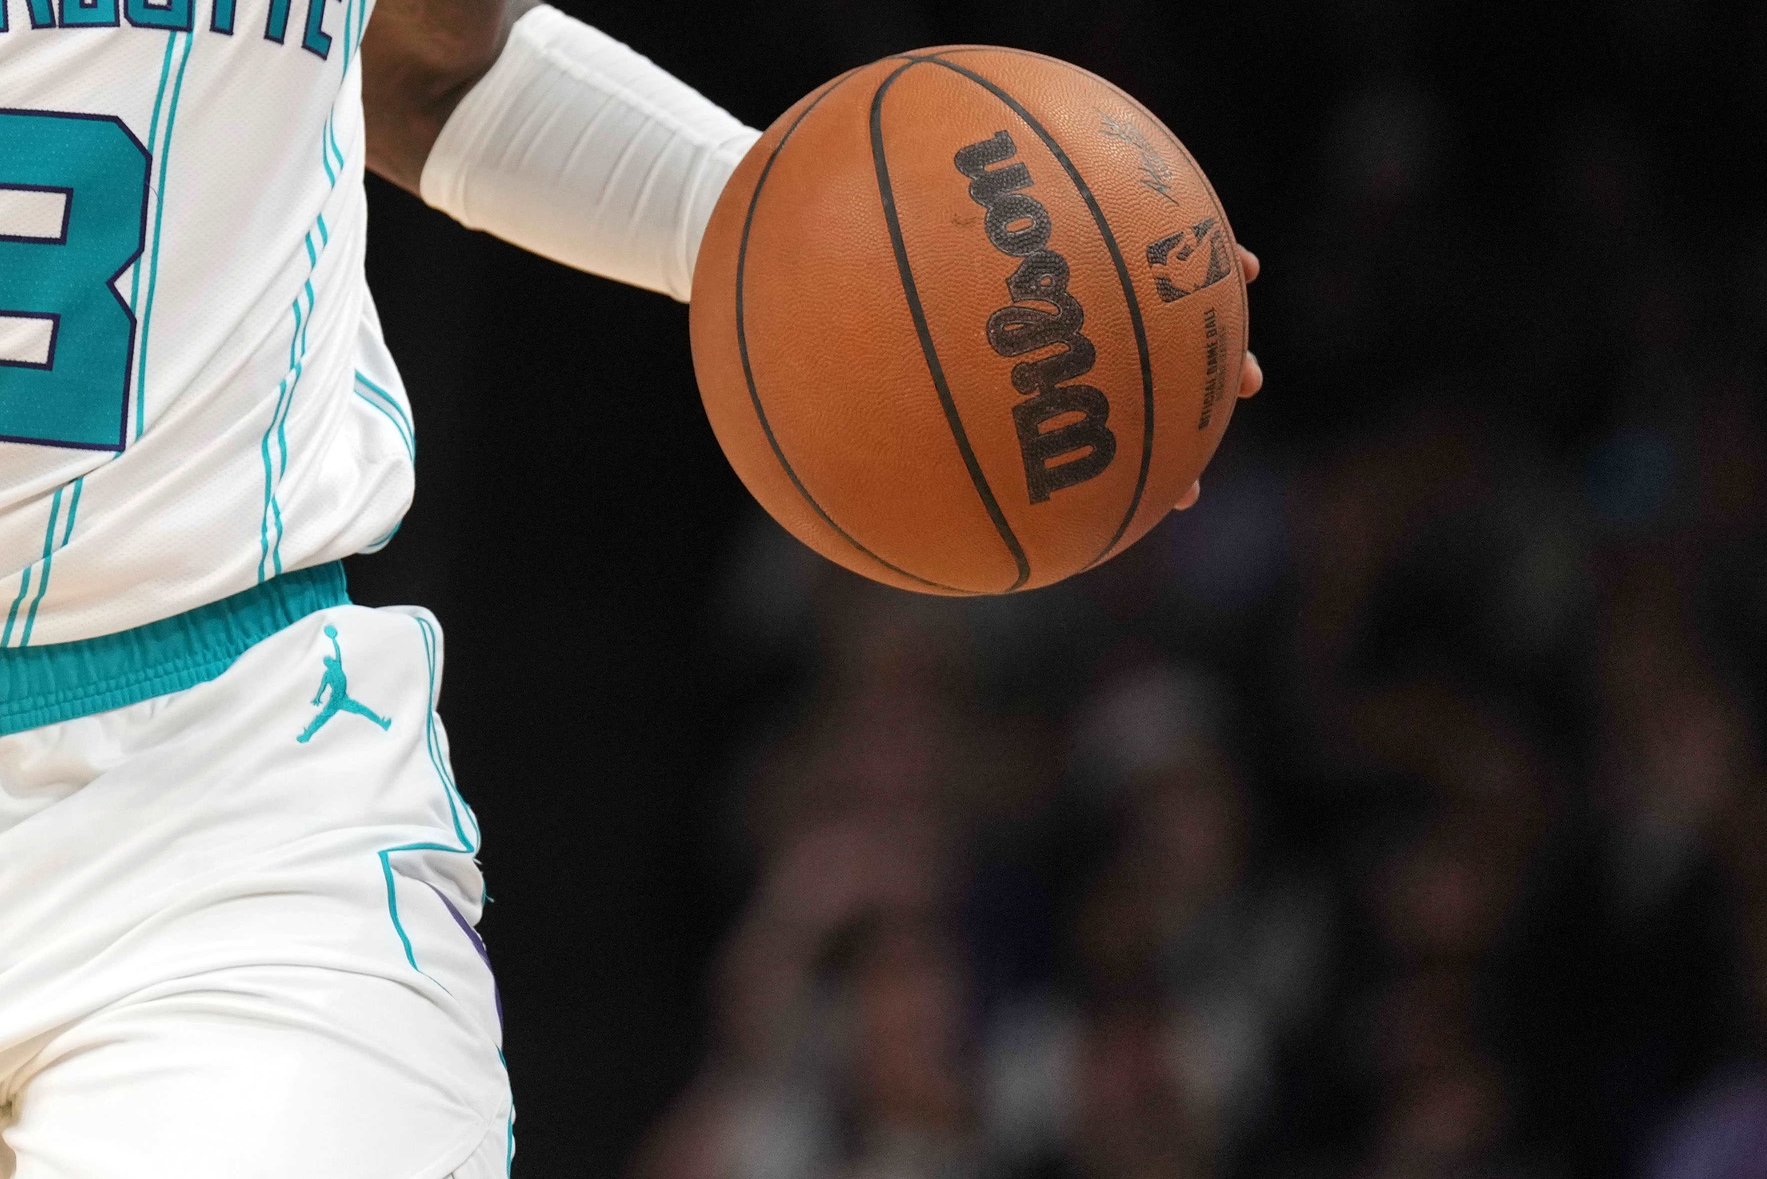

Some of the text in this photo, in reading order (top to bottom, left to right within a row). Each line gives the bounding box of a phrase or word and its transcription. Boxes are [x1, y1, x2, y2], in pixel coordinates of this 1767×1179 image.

[954, 129, 1117, 504] Wilson
[1198, 307, 1218, 431] OFFICIAL GAME BALL
